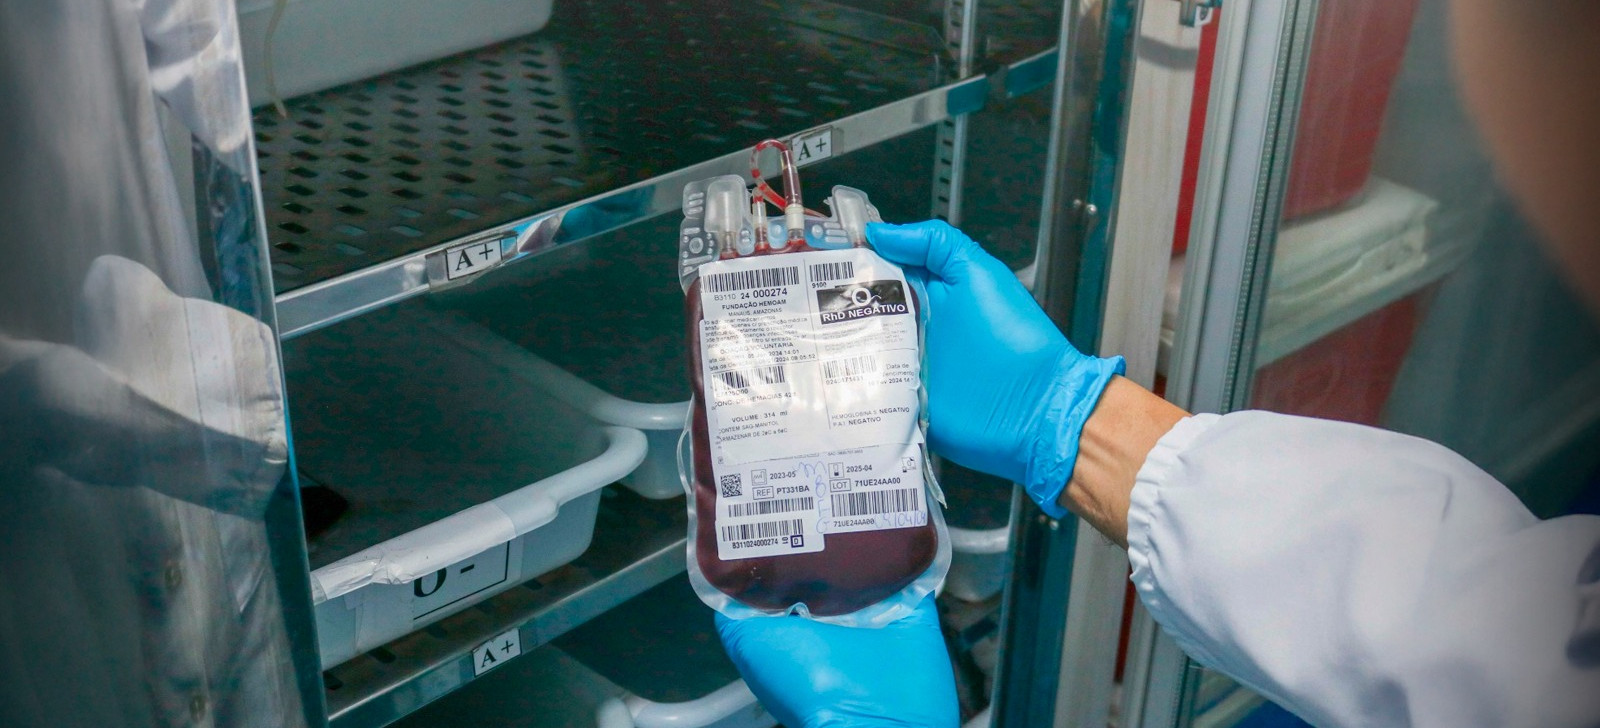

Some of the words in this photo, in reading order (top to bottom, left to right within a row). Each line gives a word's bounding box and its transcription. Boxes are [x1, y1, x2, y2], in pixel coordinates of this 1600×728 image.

[714, 293, 737, 301] B3110
[740, 292, 750, 300] 24
[752, 287, 788, 299] 000274
[811, 281, 827, 289] 9100
[722, 300, 758, 310] FUNDAÇÃO
[758, 298, 787, 307] HEMOAM
[822, 310, 846, 323] RhD
[848, 303, 906, 319] NEGATIVO
[879, 406, 911, 415] NEGATIVO
[848, 416, 882, 426] NEGATIVO
[769, 470, 796, 480] 2023-05
[846, 464, 873, 473] 2025-04
[831, 481, 848, 490] LOT
[854, 477, 901, 487] 71UE24AA00
[756, 488, 771, 497] REF
[776, 485, 810, 495] PT331BA
[833, 518, 875, 528] 71UE24AA00
